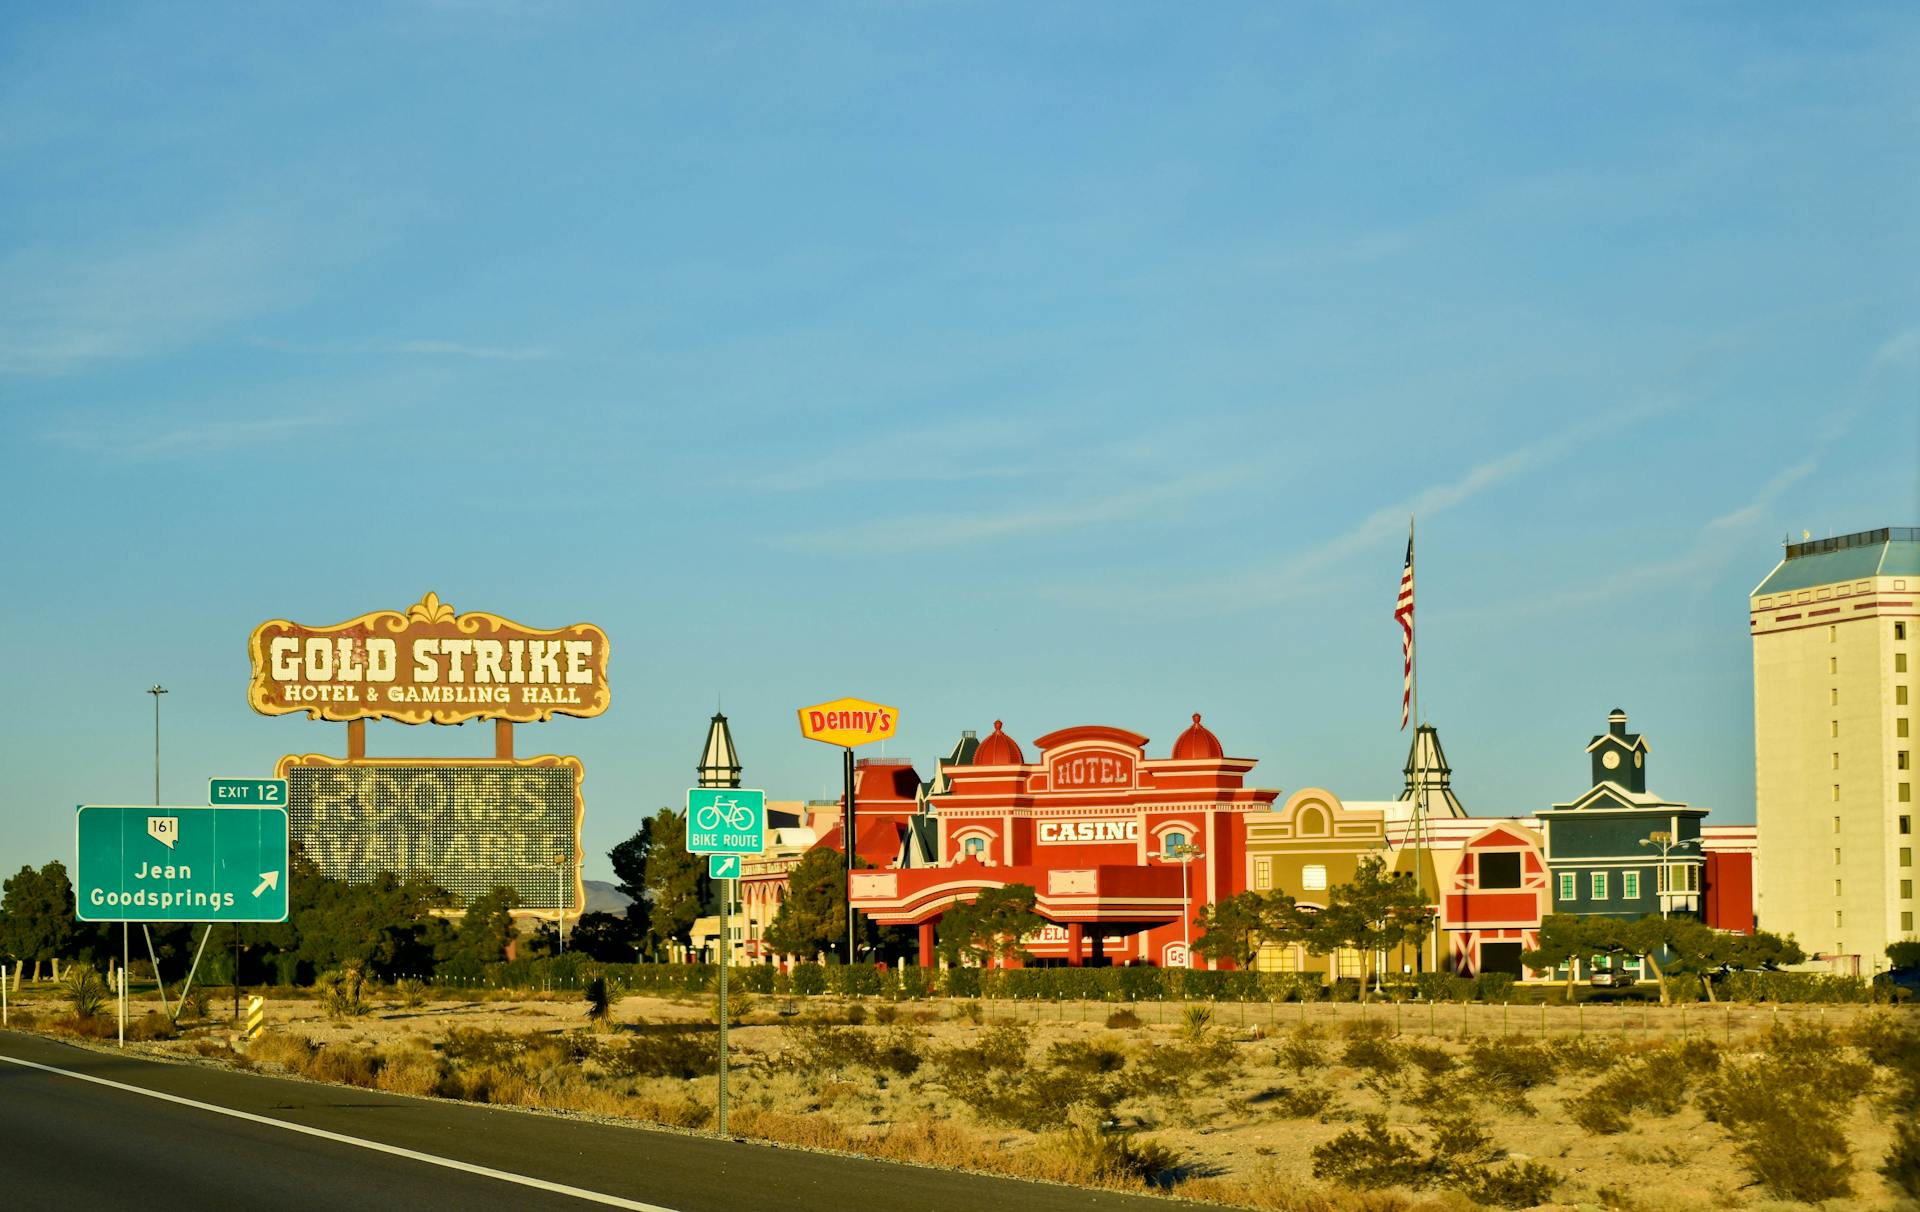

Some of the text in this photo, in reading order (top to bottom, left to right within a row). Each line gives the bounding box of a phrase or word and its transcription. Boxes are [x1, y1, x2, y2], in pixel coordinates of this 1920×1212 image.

[270, 637, 593, 685] GOLD STRIKE
[285, 685, 581, 704] HOTEL & GAMBLING HALL
[808, 708, 891, 734] Denny's
[1057, 757, 1127, 785] HOTEL
[218, 785, 278, 801] EXIT 12
[312, 773, 547, 822] ROOMS
[152, 820, 173, 833] 161
[692, 833, 758, 848] BIKE ROUTE
[134, 861, 191, 880] Jean
[90, 887, 234, 912] Goodsprings
